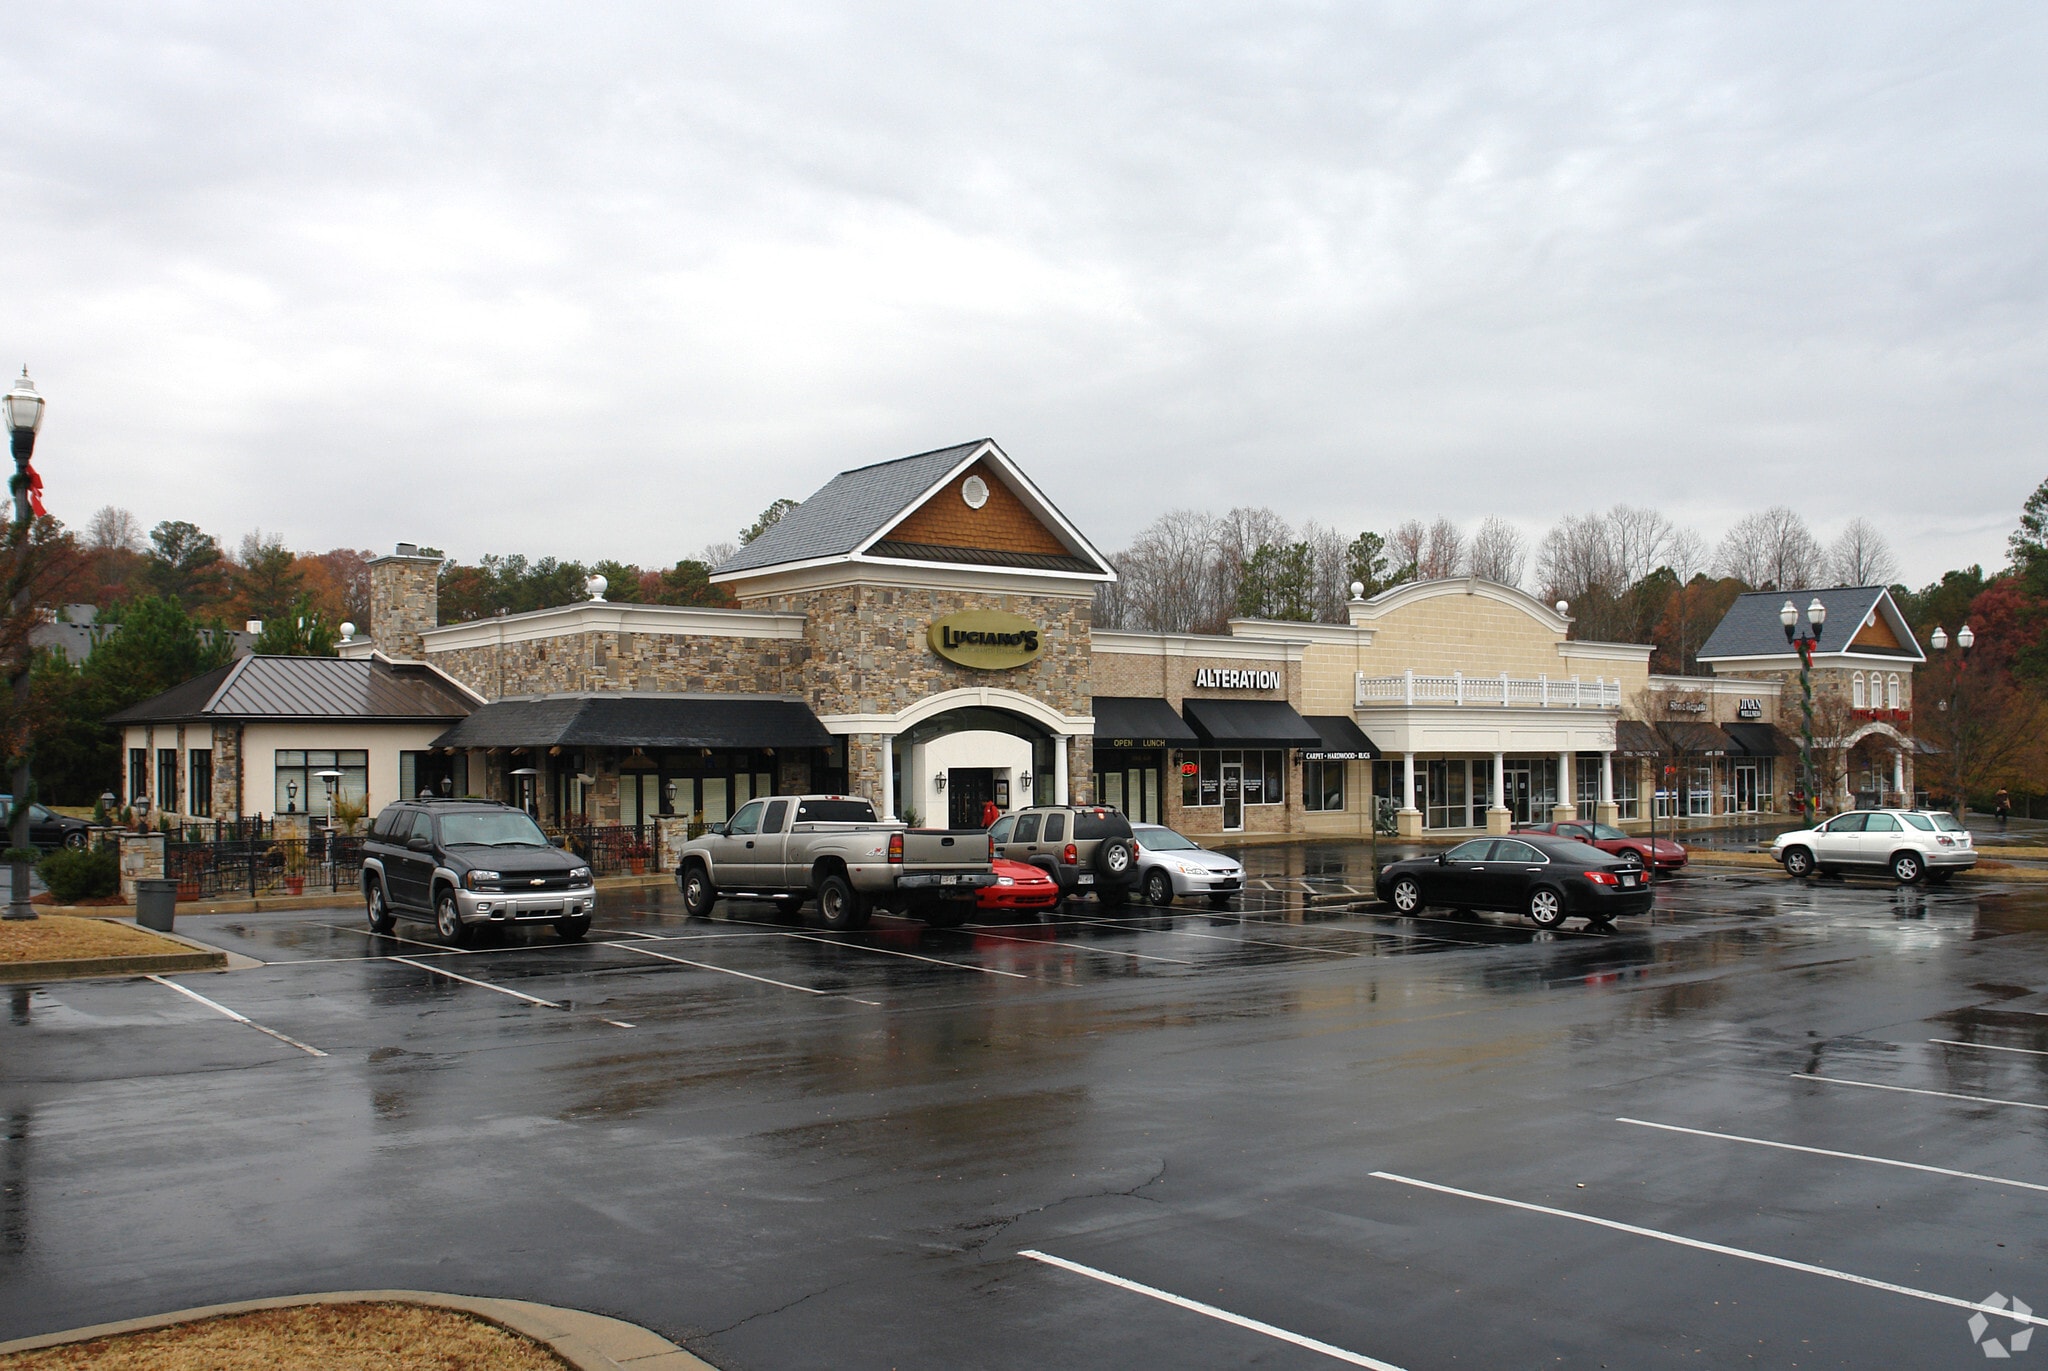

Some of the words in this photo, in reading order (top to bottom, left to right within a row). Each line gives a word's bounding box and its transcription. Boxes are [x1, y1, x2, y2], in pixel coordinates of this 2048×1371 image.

[1196, 668, 1280, 689] ALTERATION
[1113, 739, 1133, 747] OPEN
[1142, 739, 1166, 747] LUNCH
[1305, 752, 1324, 760] CARPET
